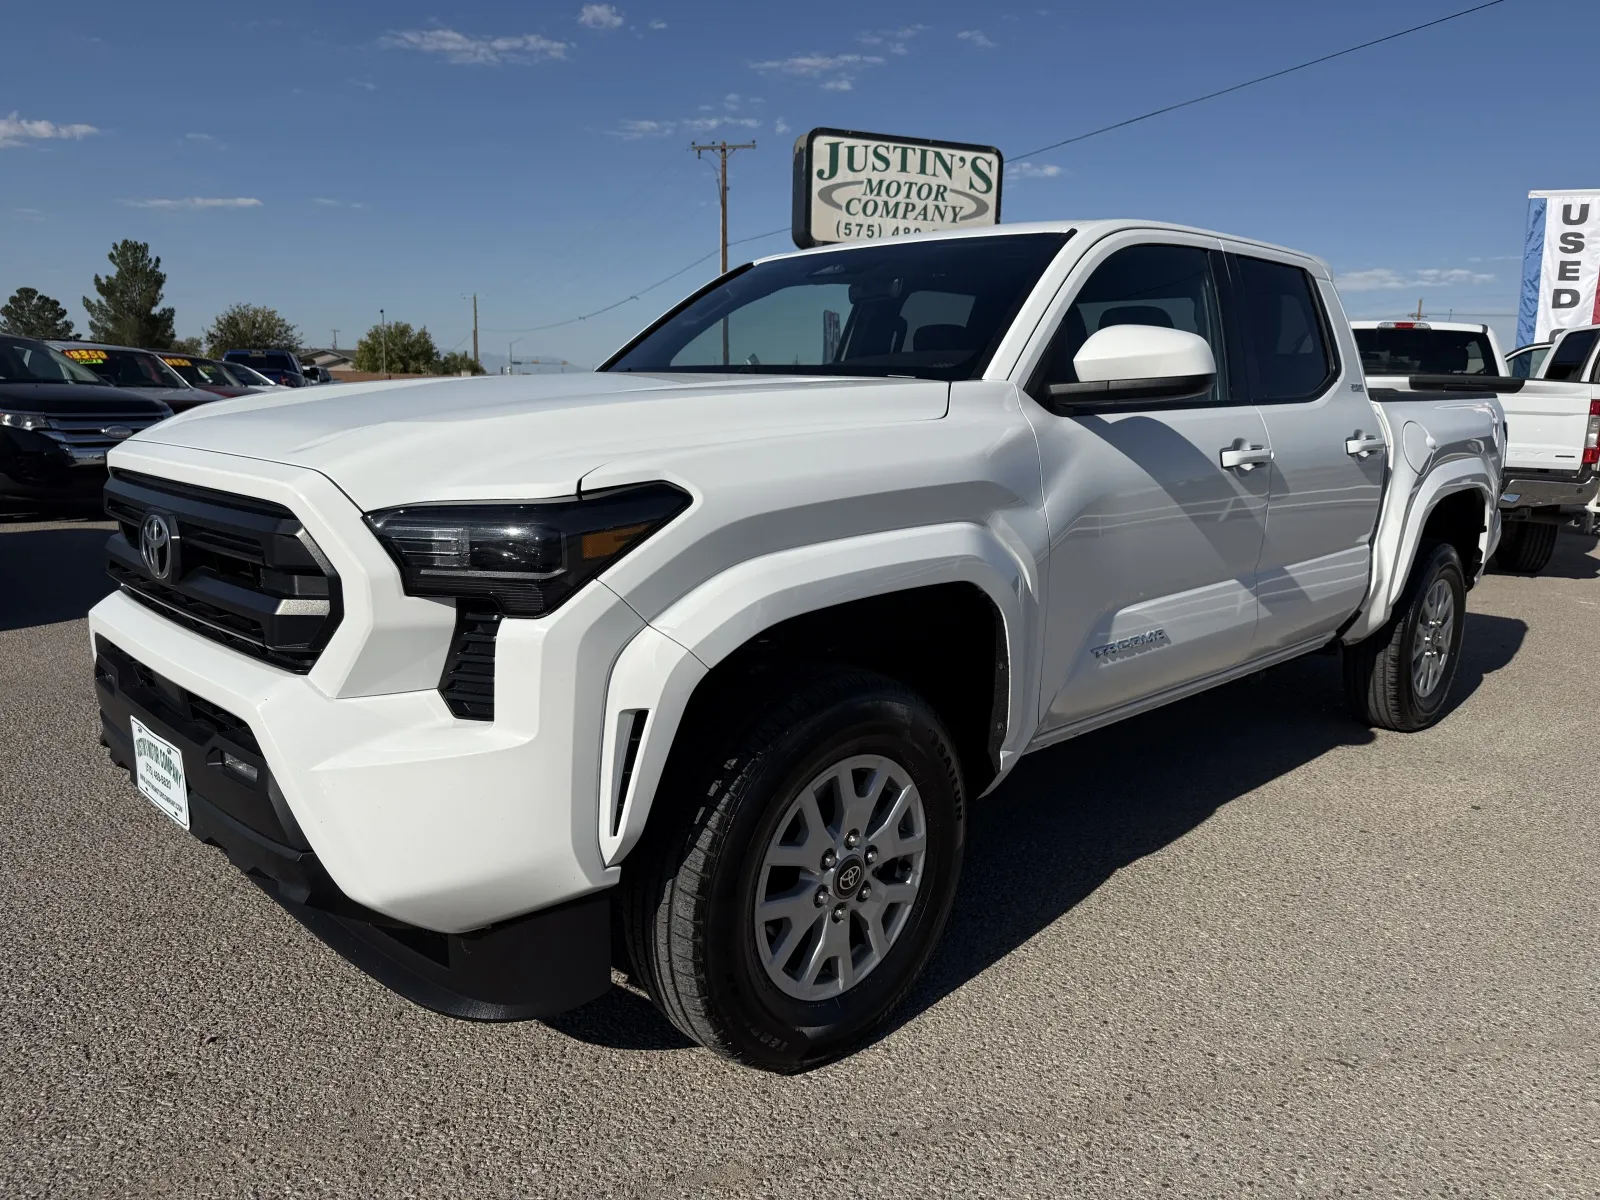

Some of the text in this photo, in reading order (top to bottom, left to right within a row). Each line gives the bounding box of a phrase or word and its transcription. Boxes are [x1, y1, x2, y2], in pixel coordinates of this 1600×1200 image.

[816, 141, 993, 194] JUSTIN'S
[862, 178, 948, 202] MOTOR
[845, 198, 964, 224] COMPANY
[836, 220, 883, 239] (575)
[1551, 203, 1590, 309] USED
